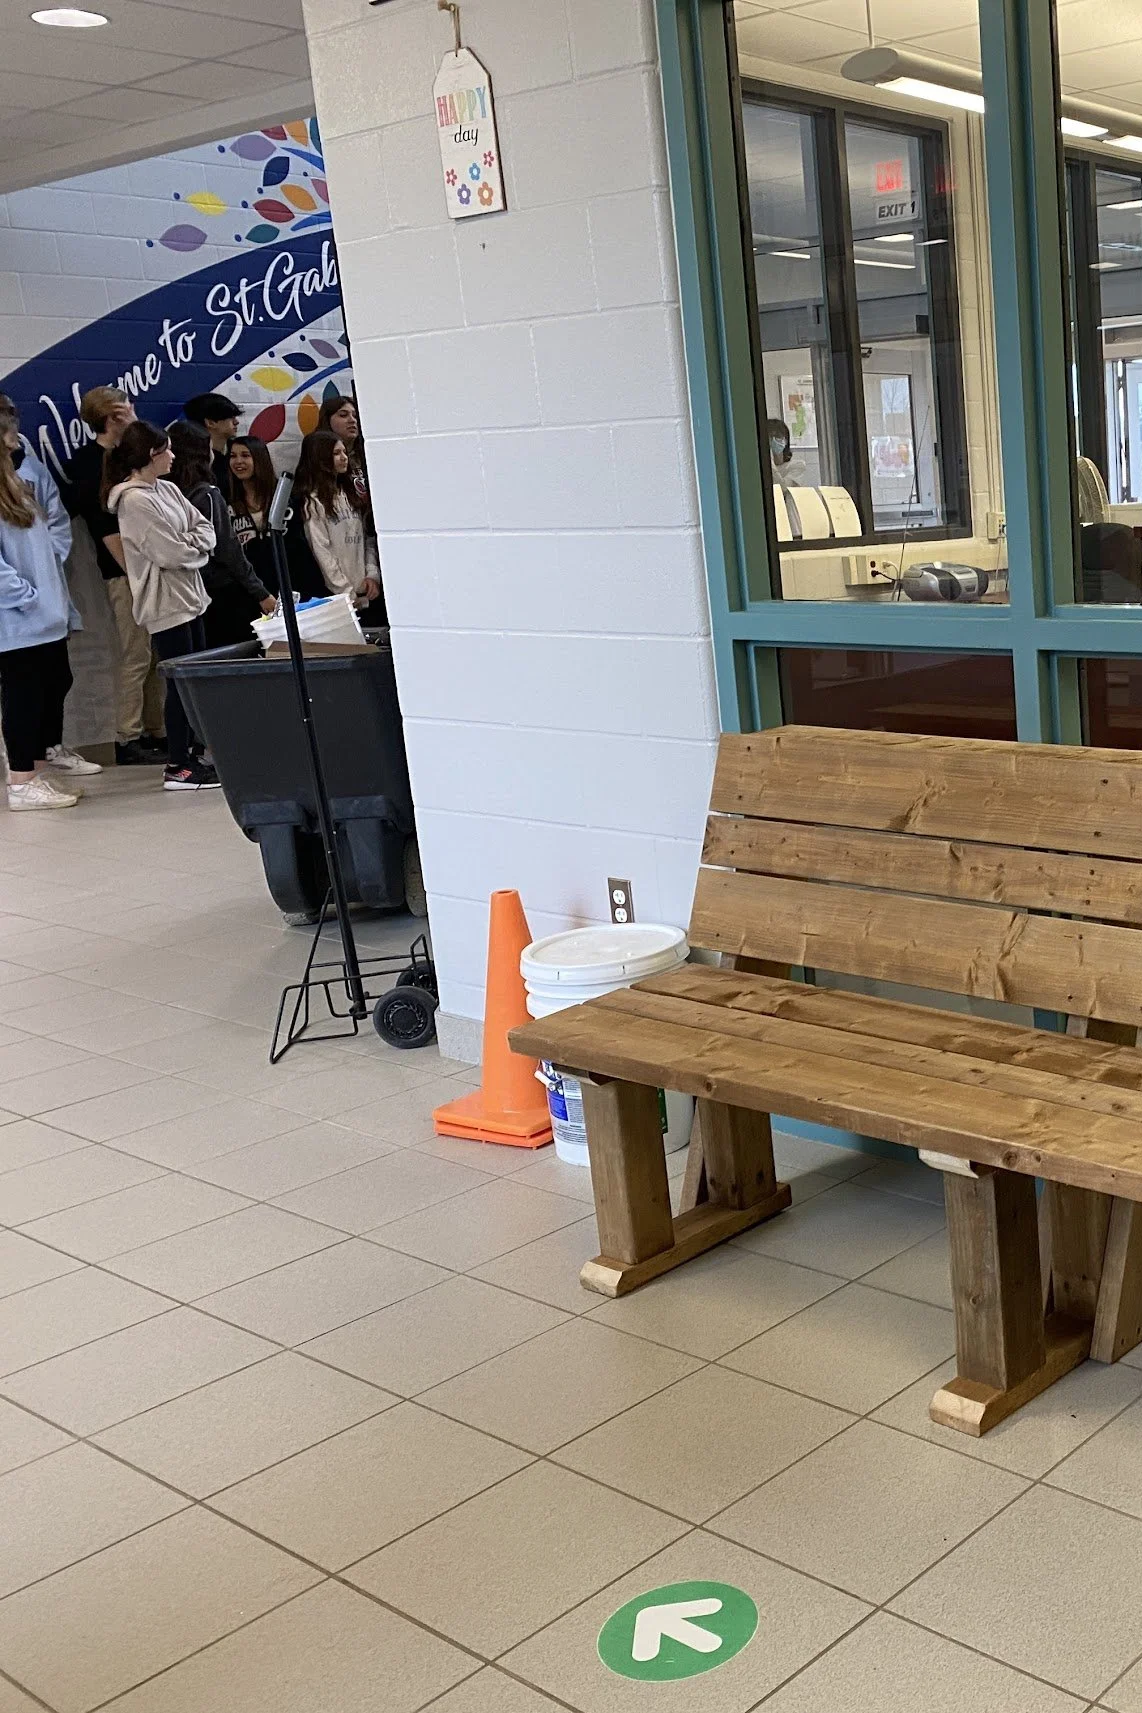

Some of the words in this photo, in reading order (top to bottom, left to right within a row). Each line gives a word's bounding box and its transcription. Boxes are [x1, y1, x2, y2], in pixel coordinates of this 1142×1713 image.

[436, 86, 487, 127] HAPPY
[454, 124, 479, 146] day
[878, 203, 906, 219] EXIT
[38, 353, 162, 485] Welme
[159, 318, 197, 369] to
